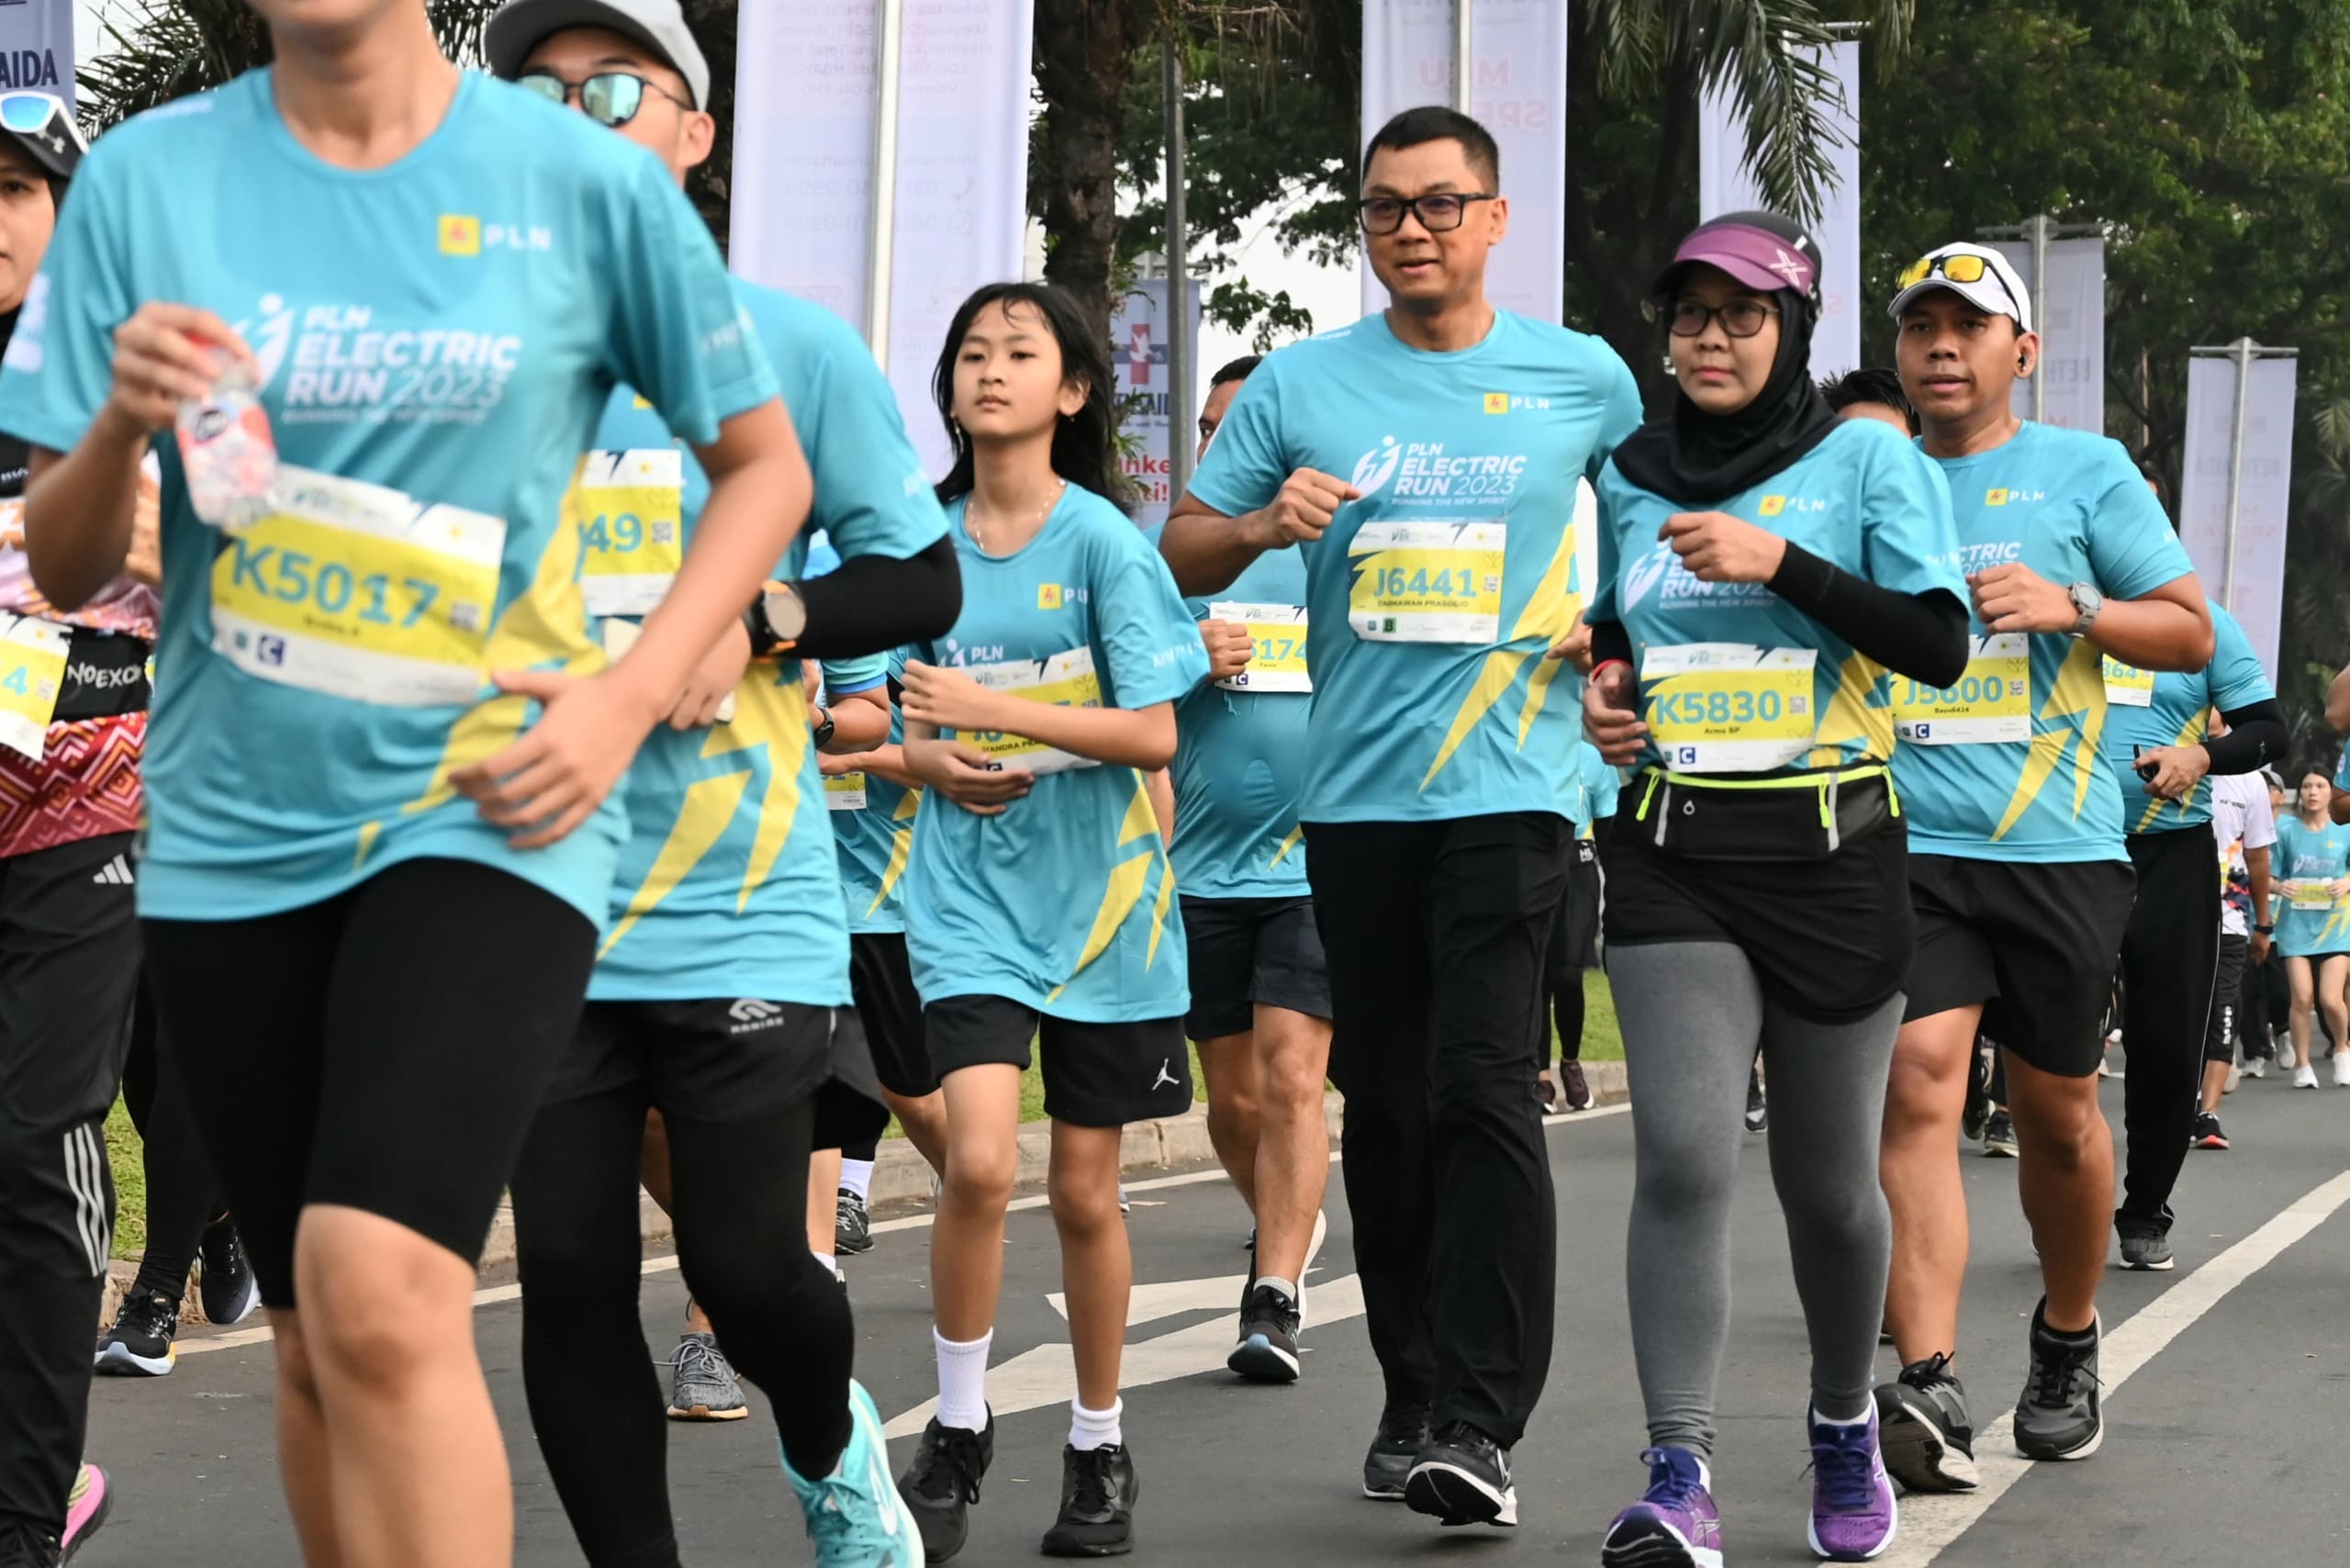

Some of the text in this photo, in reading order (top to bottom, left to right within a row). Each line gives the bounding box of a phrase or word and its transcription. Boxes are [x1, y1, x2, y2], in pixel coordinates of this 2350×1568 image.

[485, 224, 552, 249] PLN
[304, 306, 371, 329] PLN
[292, 331, 521, 369] ELECTRIC
[283, 366, 510, 408] RUN 2023
[1511, 397, 1550, 409] PLN
[1406, 442, 1444, 456] PLN
[1401, 454, 1528, 476] ELECTRIC
[1393, 474, 1518, 497] RUN 2023
[2009, 491, 2045, 501] PLN
[231, 538, 441, 629] K5017
[1373, 566, 1477, 598] J6441
[1661, 579, 1714, 599] RUN
[971, 646, 1003, 660] PLN
[1656, 689, 1781, 725] K5830
[1917, 725, 1928, 737] C
[1681, 749, 1694, 762] C
